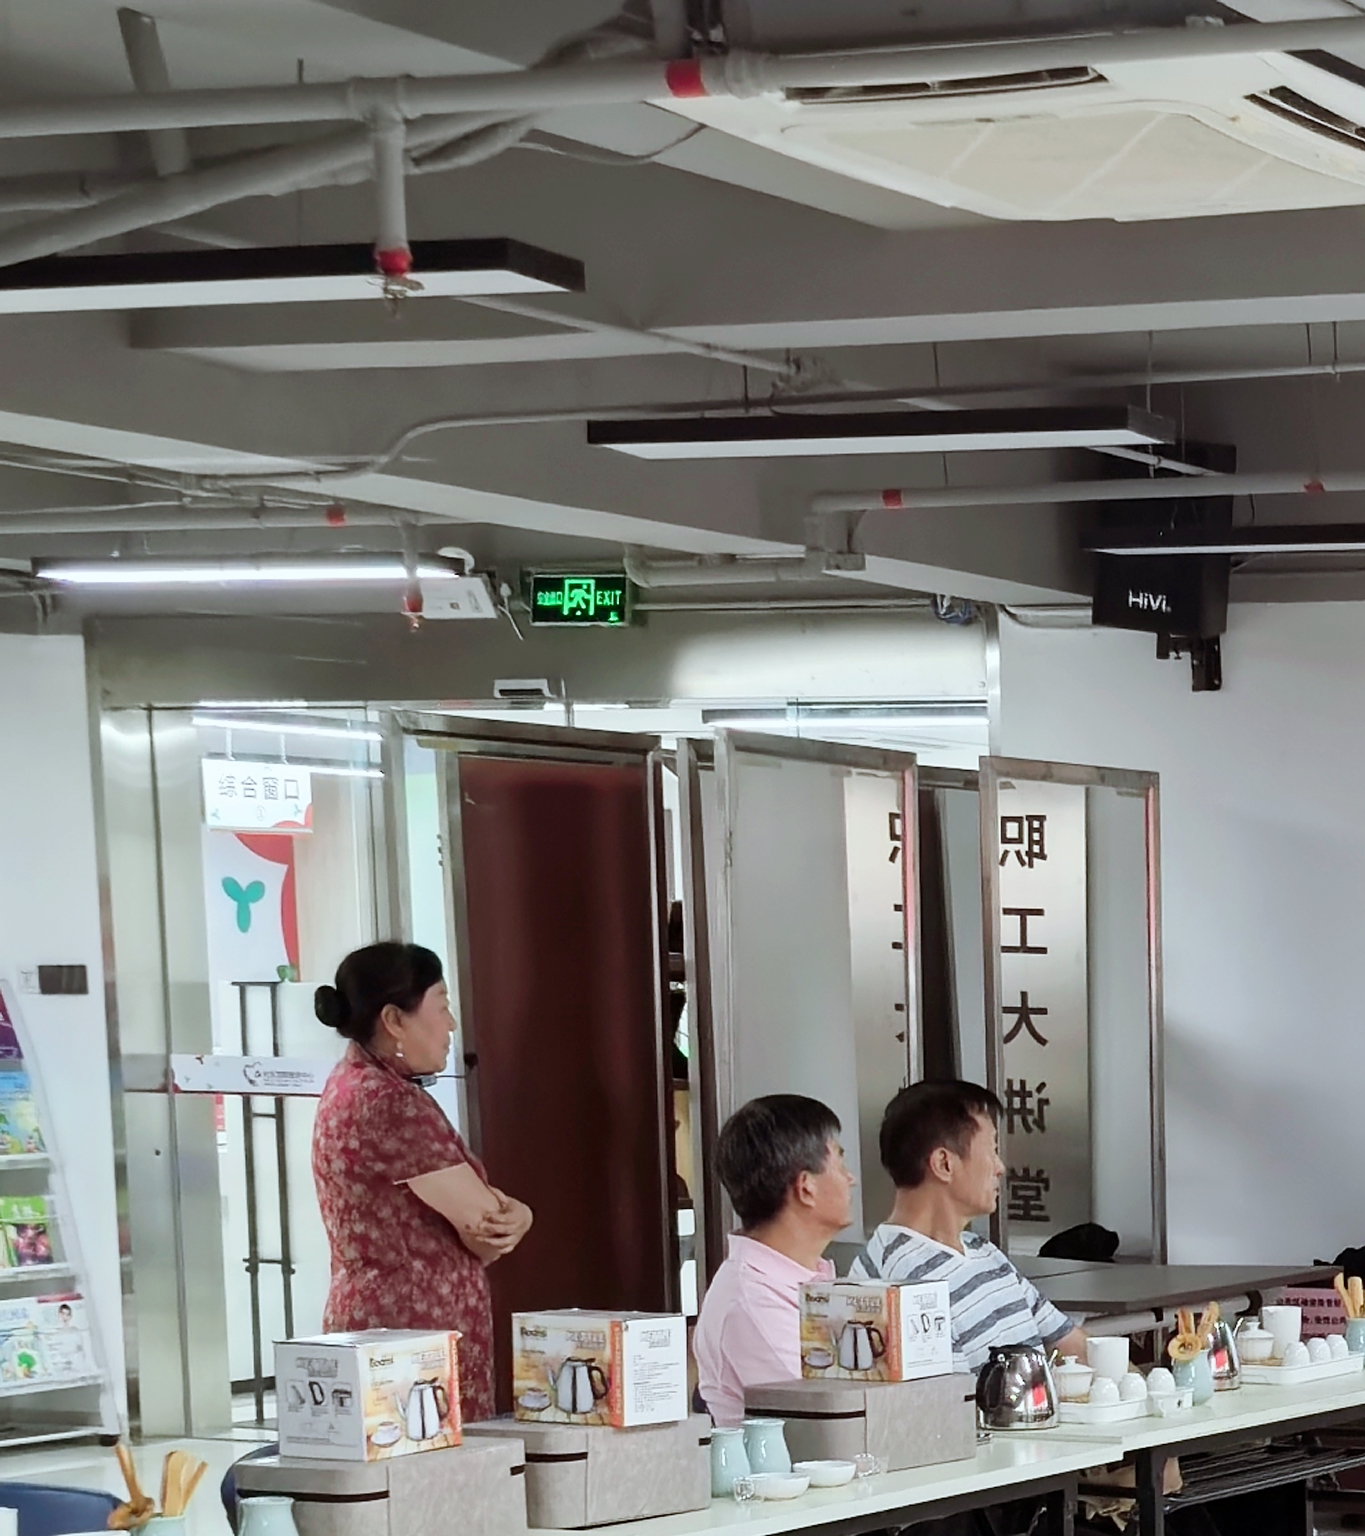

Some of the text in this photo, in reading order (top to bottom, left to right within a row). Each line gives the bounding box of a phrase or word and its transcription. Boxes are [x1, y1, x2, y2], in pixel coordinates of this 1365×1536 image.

[596, 590, 622, 606] EXIT
[1128, 588, 1167, 613] HiVi
[218, 774, 300, 801] 综合窗口
